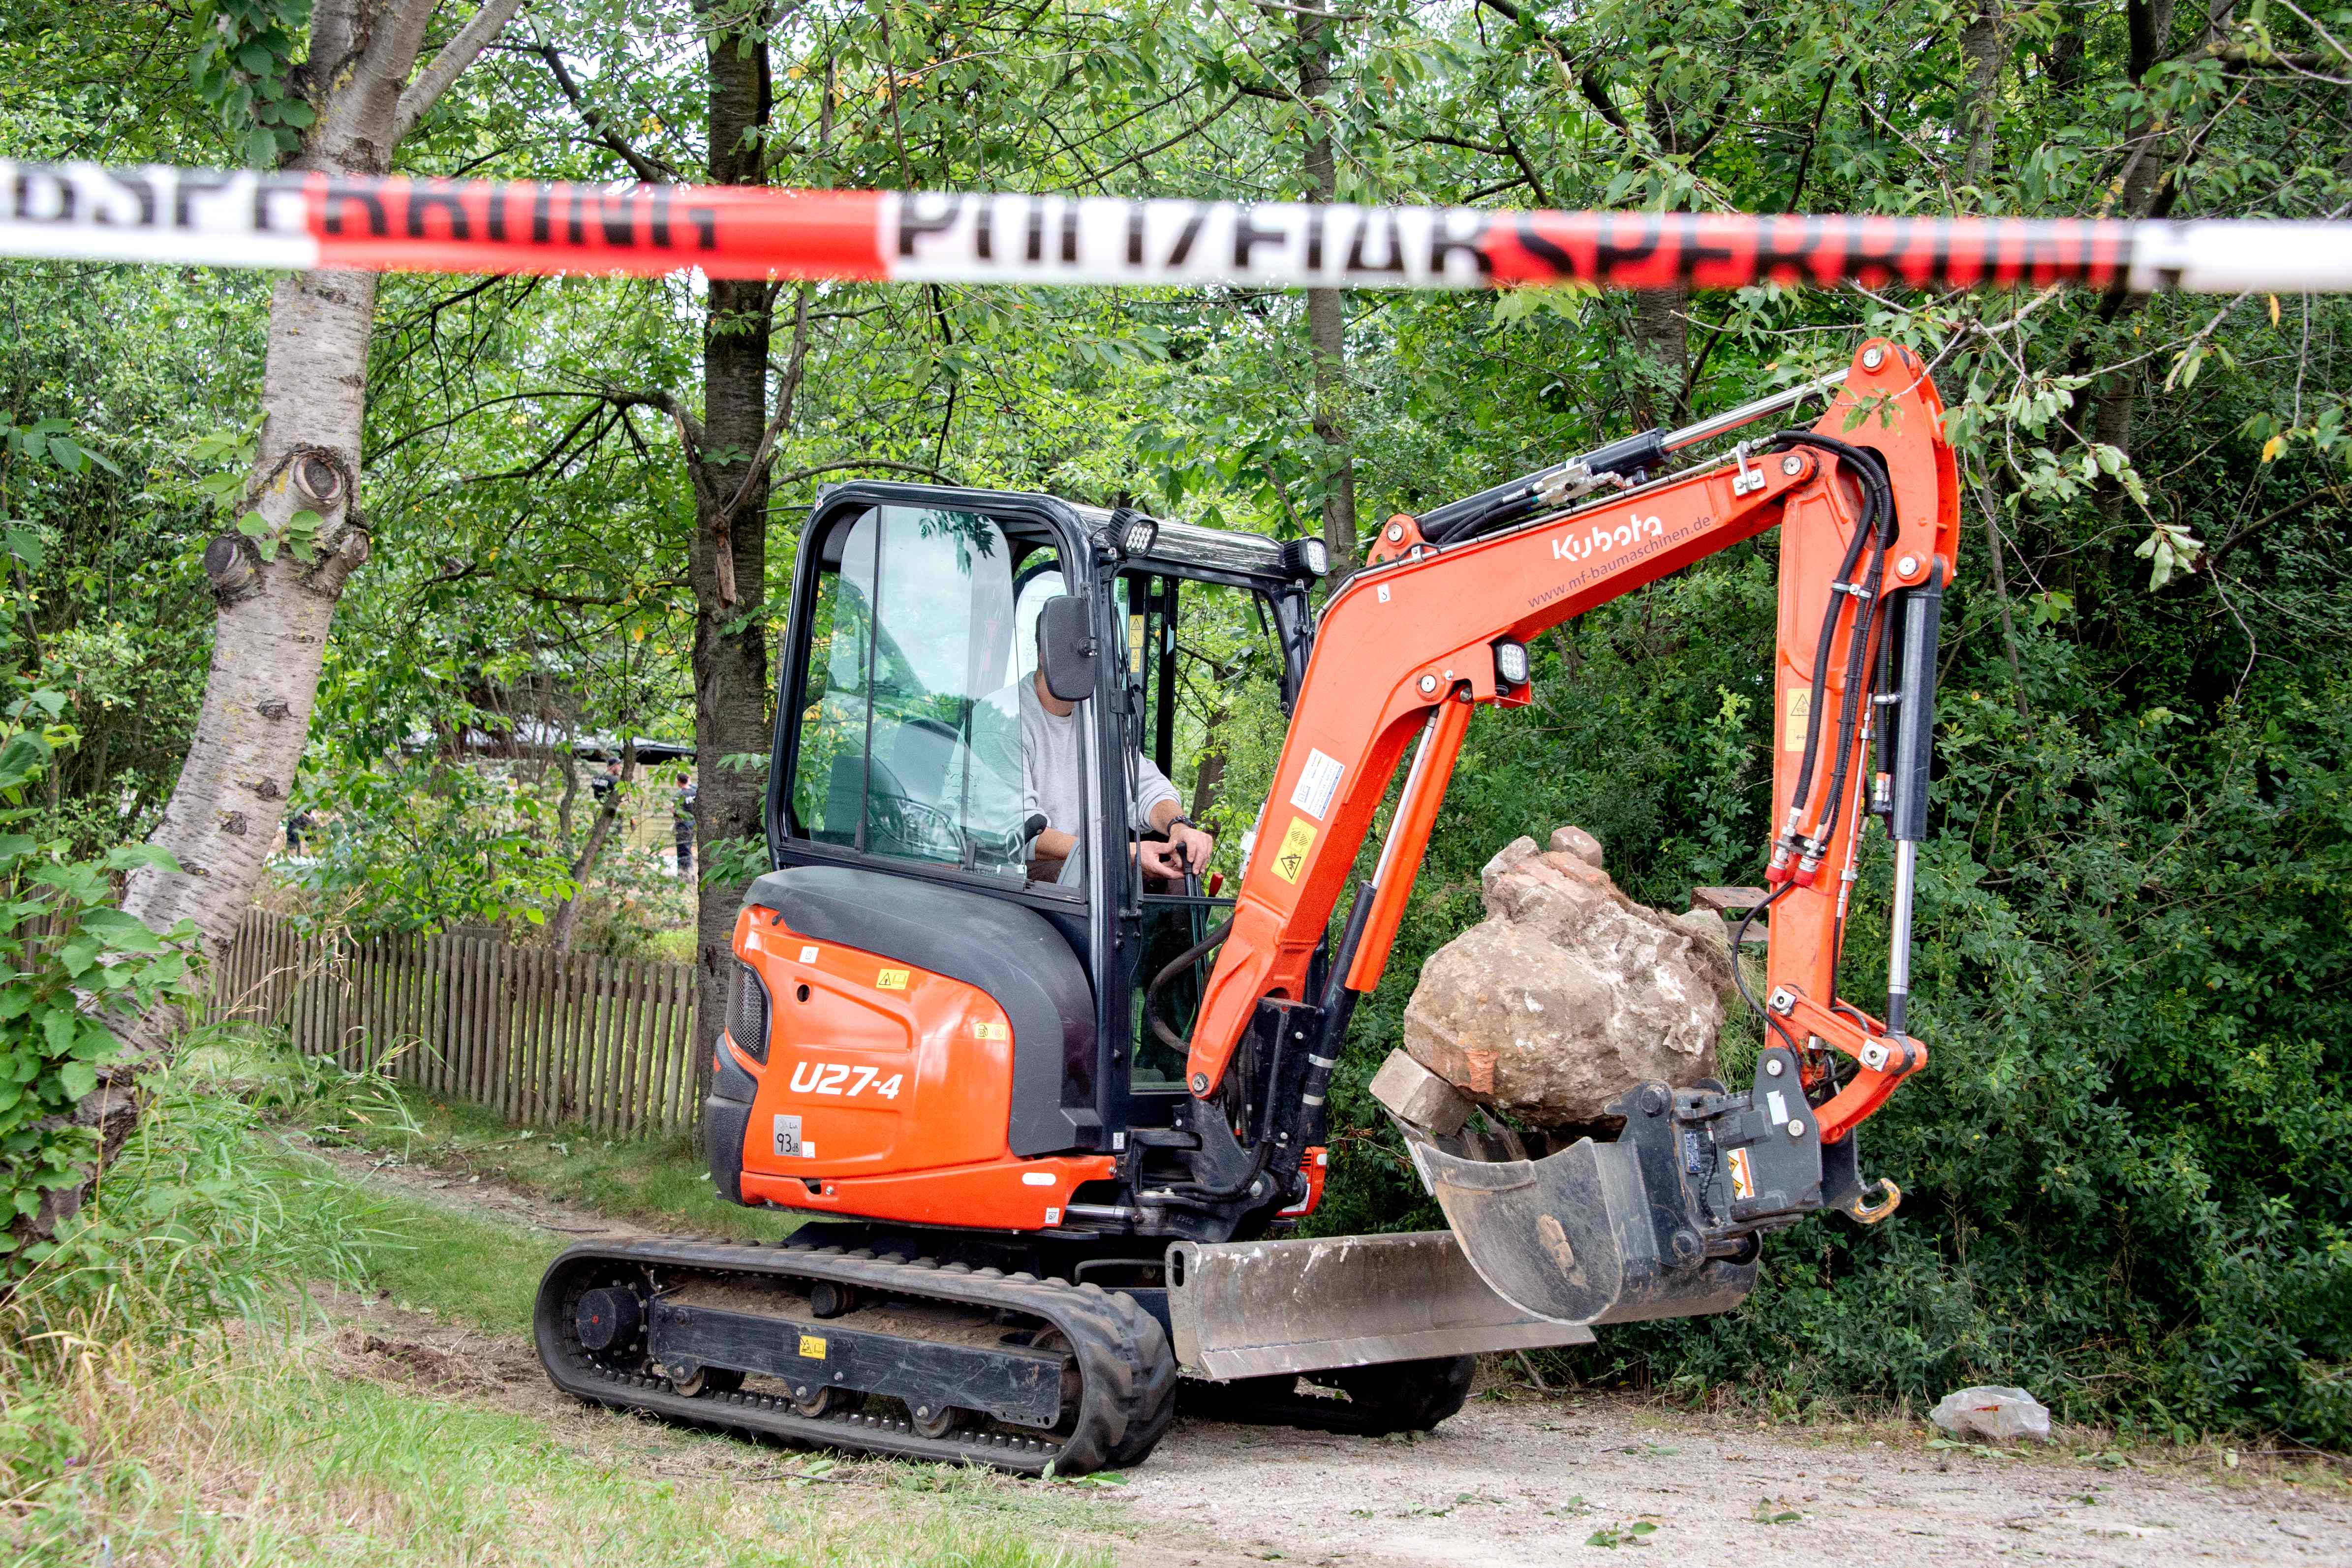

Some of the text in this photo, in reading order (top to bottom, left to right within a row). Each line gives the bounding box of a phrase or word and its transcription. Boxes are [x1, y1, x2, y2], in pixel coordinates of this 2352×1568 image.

[1552, 514, 1663, 561] Kubota
[1528, 515, 1711, 608] www.mf-baumaschinen.de
[790, 1062, 903, 1099] U27-4
